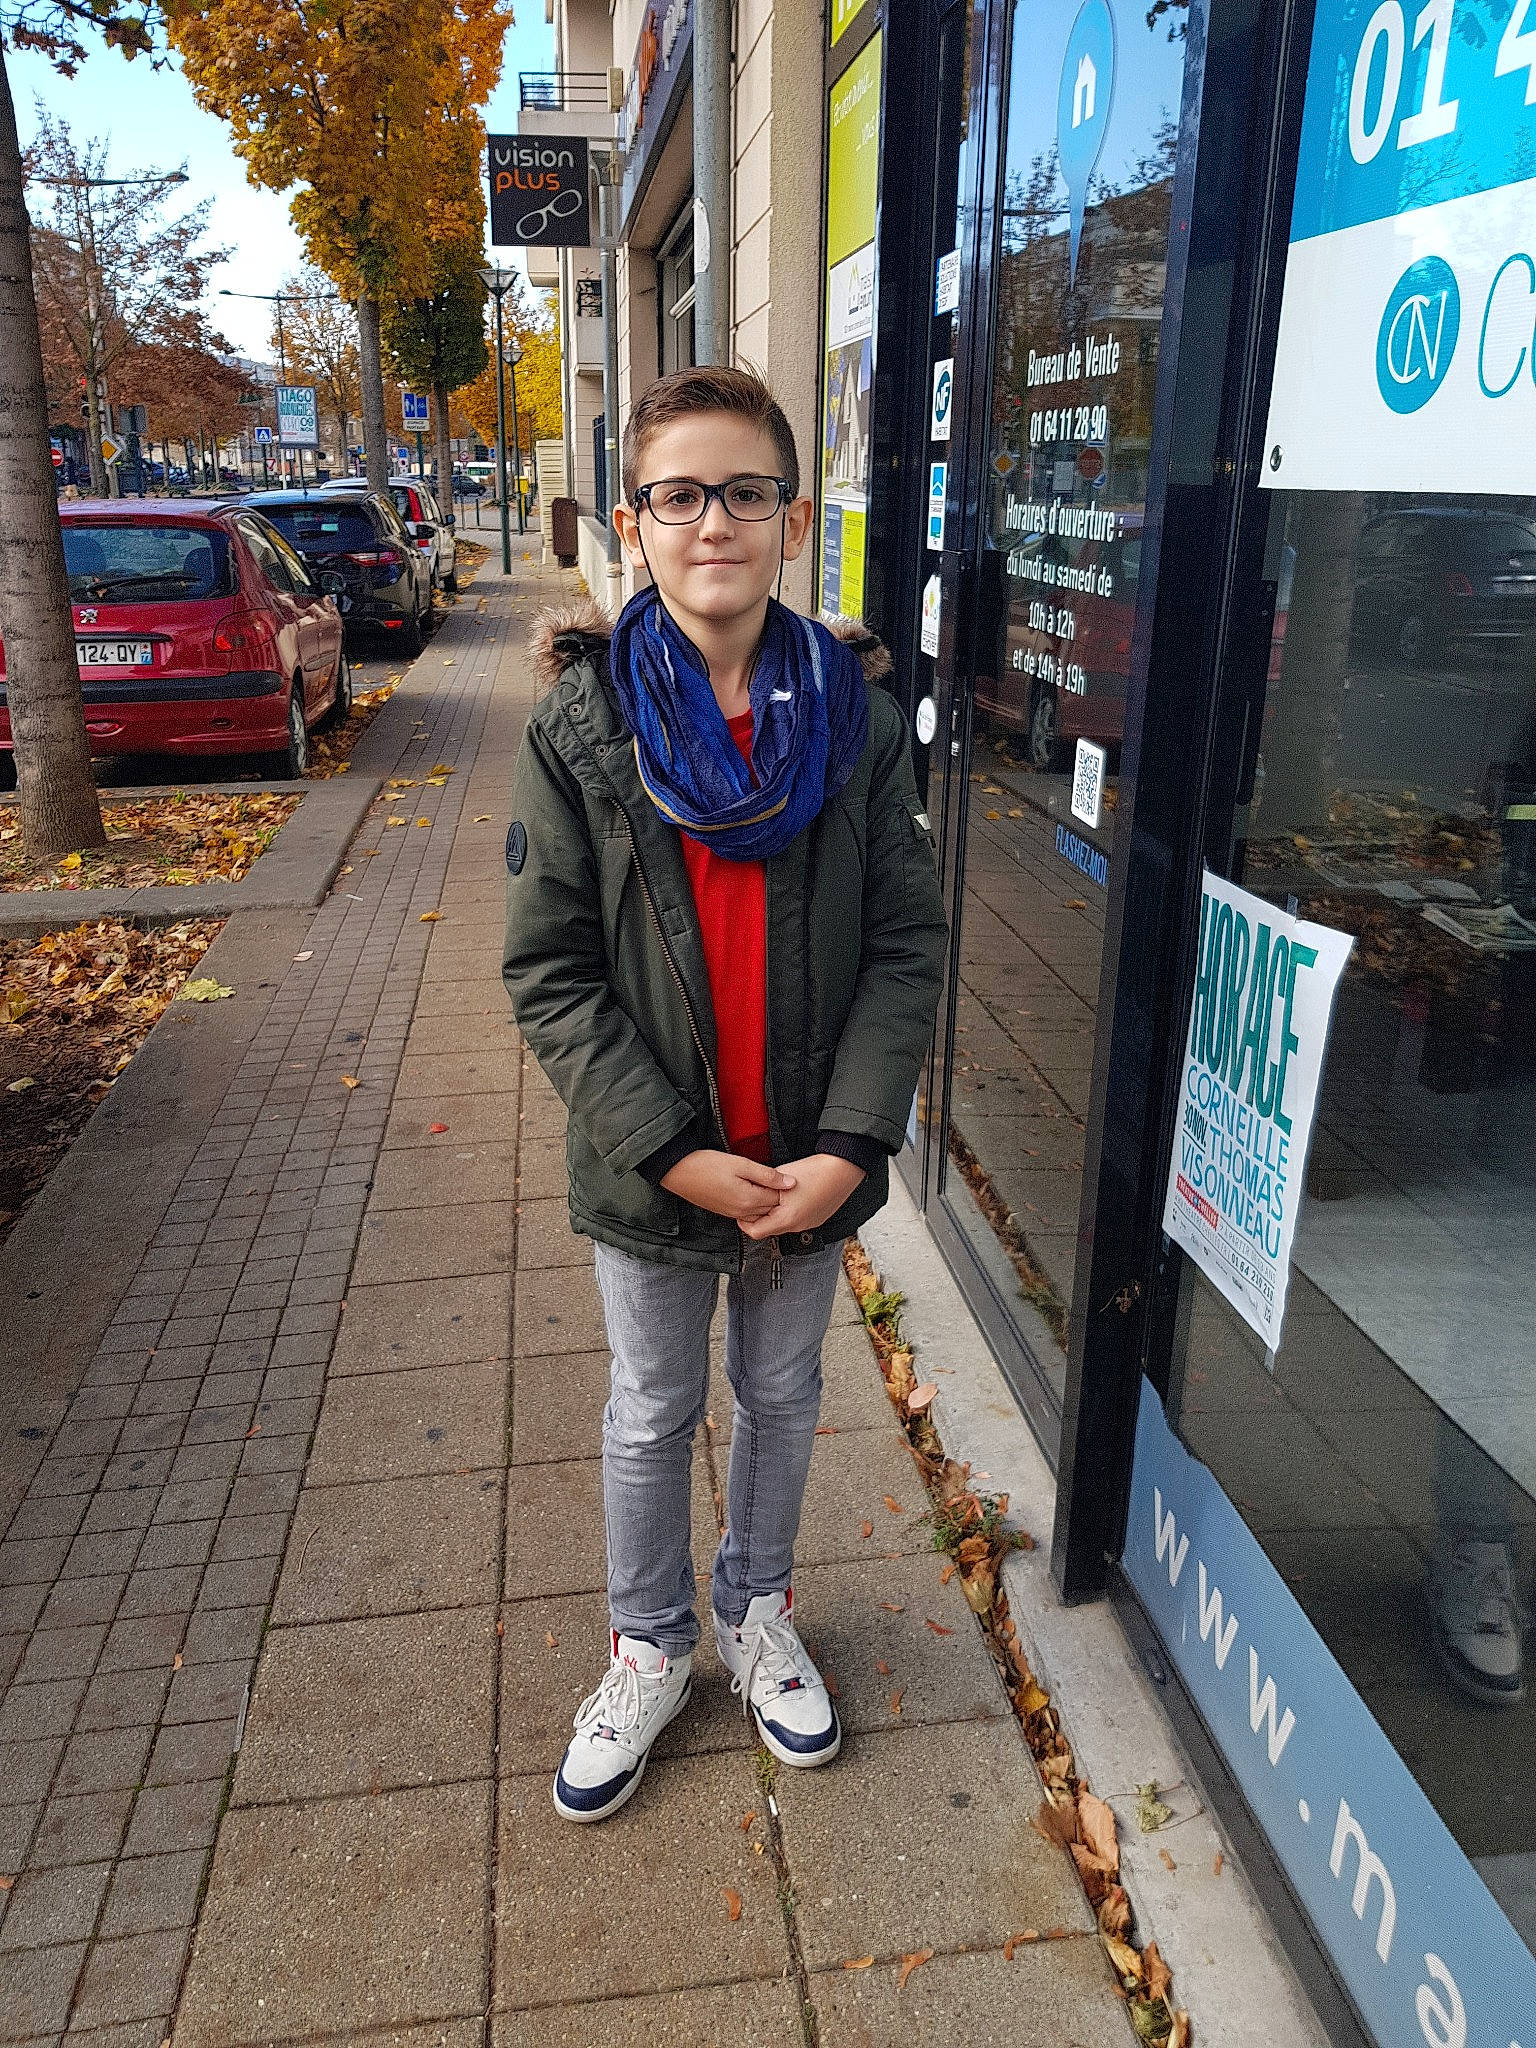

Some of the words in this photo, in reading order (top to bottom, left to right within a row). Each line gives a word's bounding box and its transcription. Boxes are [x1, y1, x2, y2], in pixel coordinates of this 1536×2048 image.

[1348, 0, 1460, 165] 01
[495, 141, 575, 168] vision
[496, 168, 561, 195] plus
[1478, 253, 1536, 398] C
[1027, 349, 1064, 387] Bureau
[1067, 342, 1081, 381] de
[1085, 333, 1120, 378] Vente
[280, 389, 312, 402] TIAGO
[1030, 411, 1043, 443] 01
[1044, 409, 1058, 442] 64
[1060, 408, 1073, 441] 11
[1074, 406, 1090, 440] 28
[1091, 405, 1107, 440] 90
[1006, 494, 1046, 533] Horaires
[1049, 497, 1115, 542] d'ouverture
[1006, 550, 1019, 575] du
[1019, 551, 1042, 581] lundi
[1043, 563, 1056, 585] au
[1056, 564, 1096, 594] samedi
[1097, 566, 1112, 597] de
[1028, 602, 1045, 631] 10h
[1047, 605, 1054, 634] à
[1056, 609, 1075, 640] 12h
[1013, 648, 1023, 670] et
[1024, 648, 1035, 675] de
[1037, 653, 1055, 683] 14h
[1056, 658, 1063, 687] à
[1065, 663, 1085, 696] 19h
[1056, 824, 1109, 887] FLASHEZ-MOI
[1190, 893, 1319, 1137] HORACE
[1187, 1065, 1289, 1182] CORNEILLE
[1182, 1136, 1280, 1259] VISONNEAU
[1210, 1124, 1284, 1222] THOMAS
